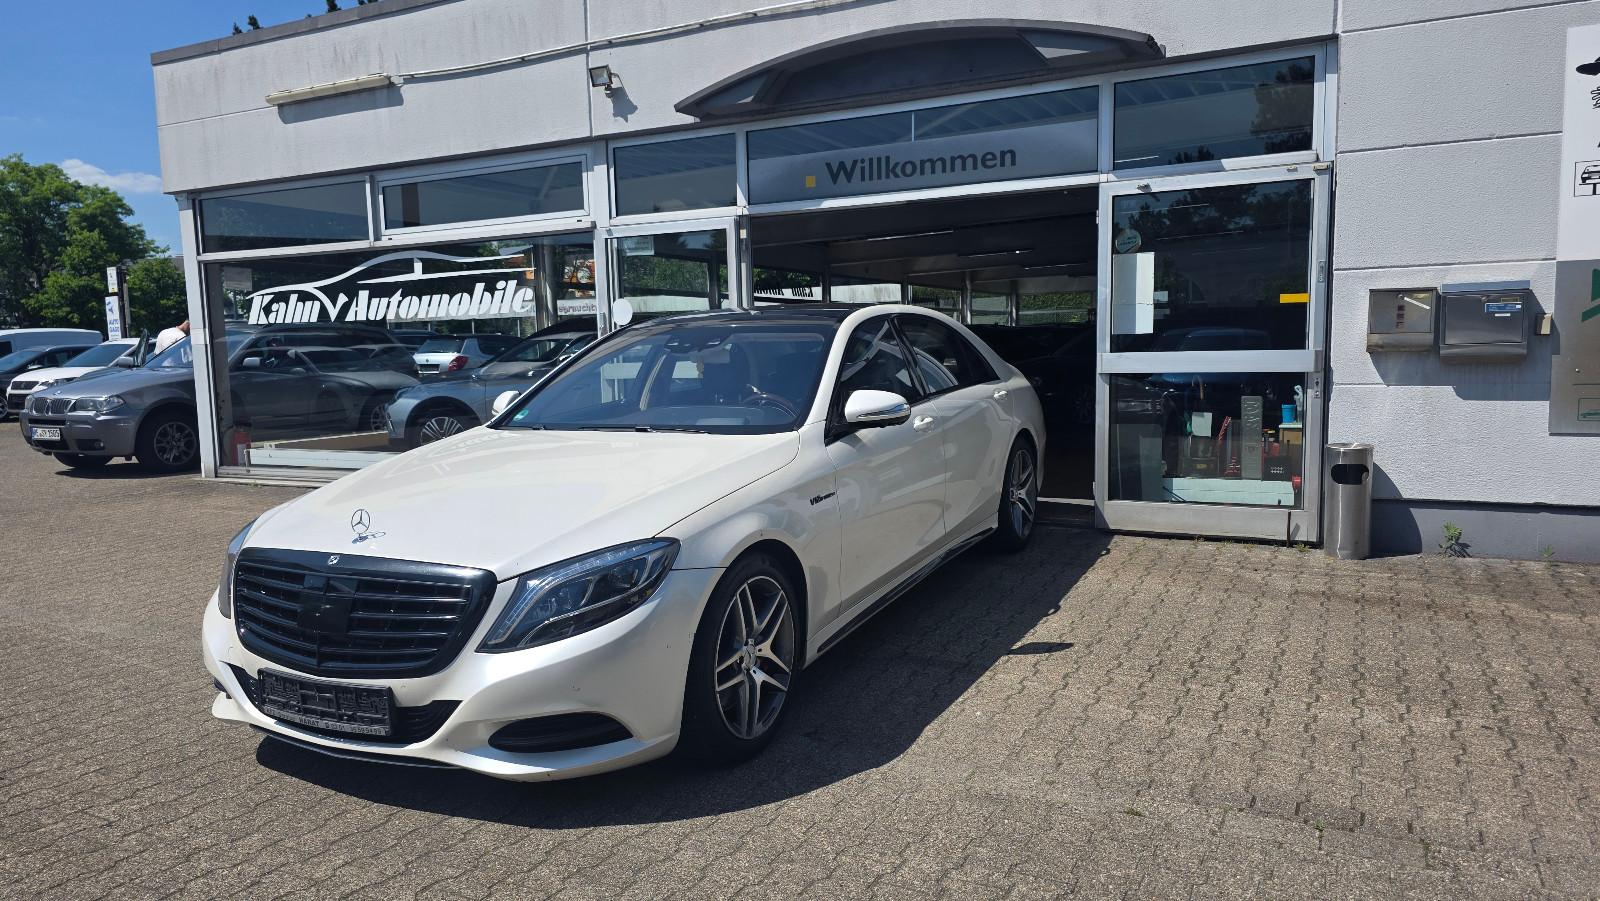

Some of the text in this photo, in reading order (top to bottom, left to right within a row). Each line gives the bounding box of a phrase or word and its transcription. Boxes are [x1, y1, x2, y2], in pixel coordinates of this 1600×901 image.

[825, 148, 1017, 185] Willkommen
[248, 279, 534, 325] Kahn Automobile
